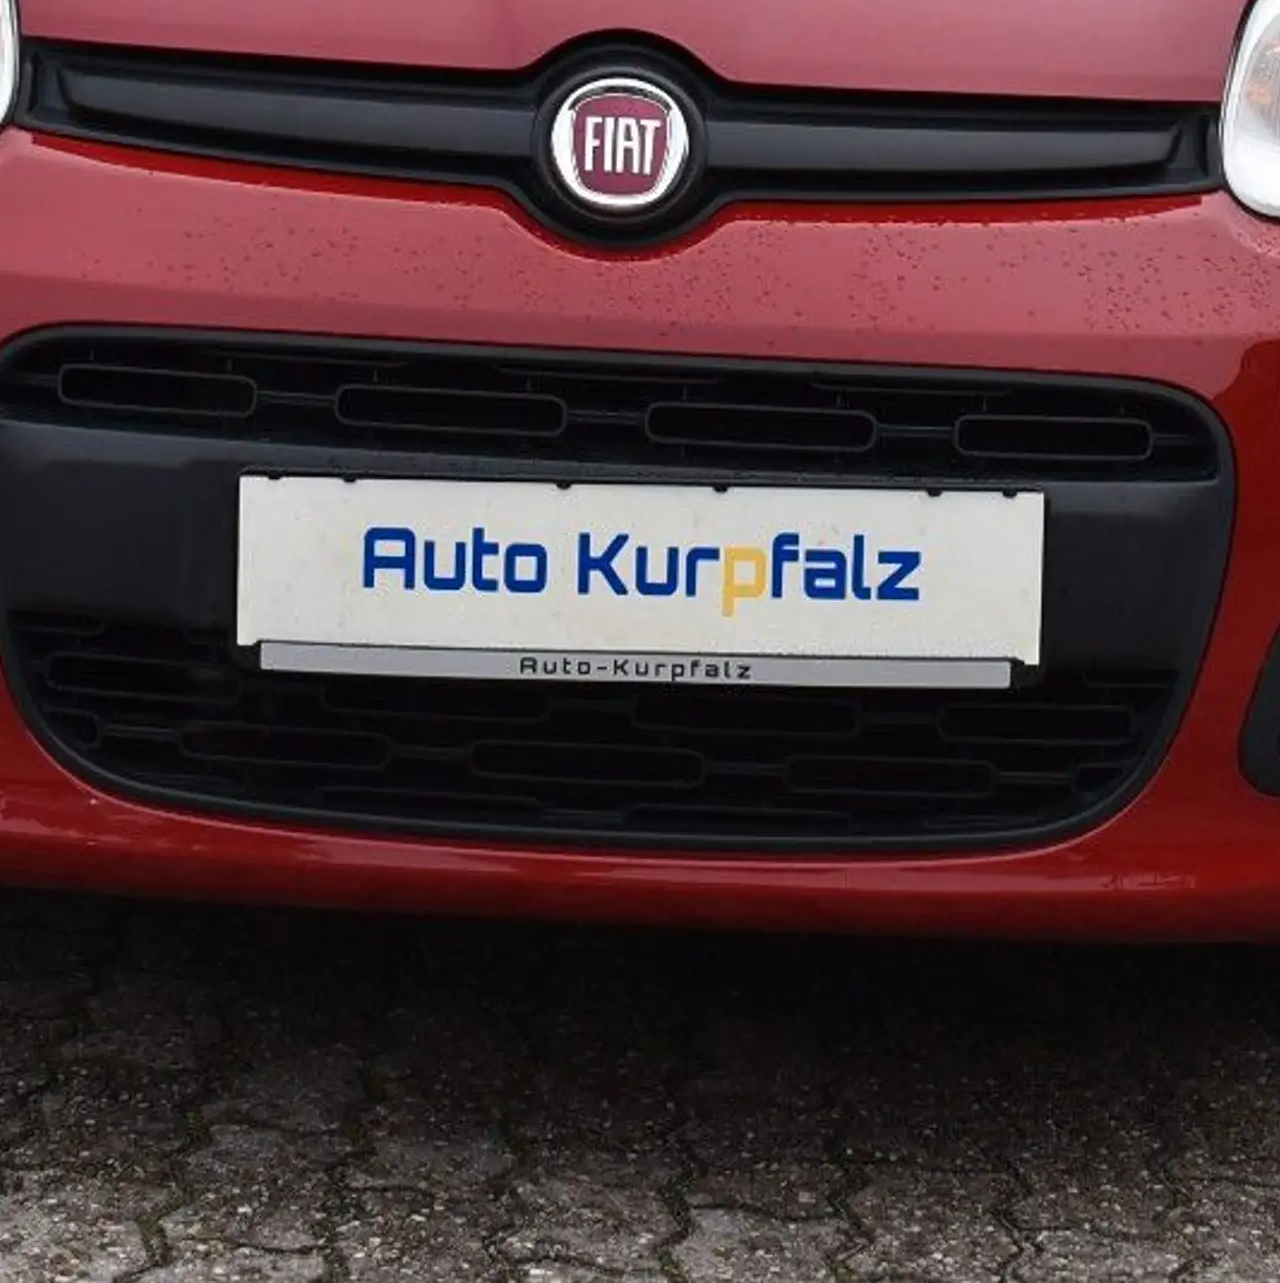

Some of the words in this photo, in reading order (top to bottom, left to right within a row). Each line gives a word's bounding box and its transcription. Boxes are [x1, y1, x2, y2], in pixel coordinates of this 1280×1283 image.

[584, 116, 662, 175] FIAT
[363, 527, 548, 594] Auto
[577, 532, 921, 617] Kurpfalz
[519, 656, 752, 681] Auto-Kurpfalz
